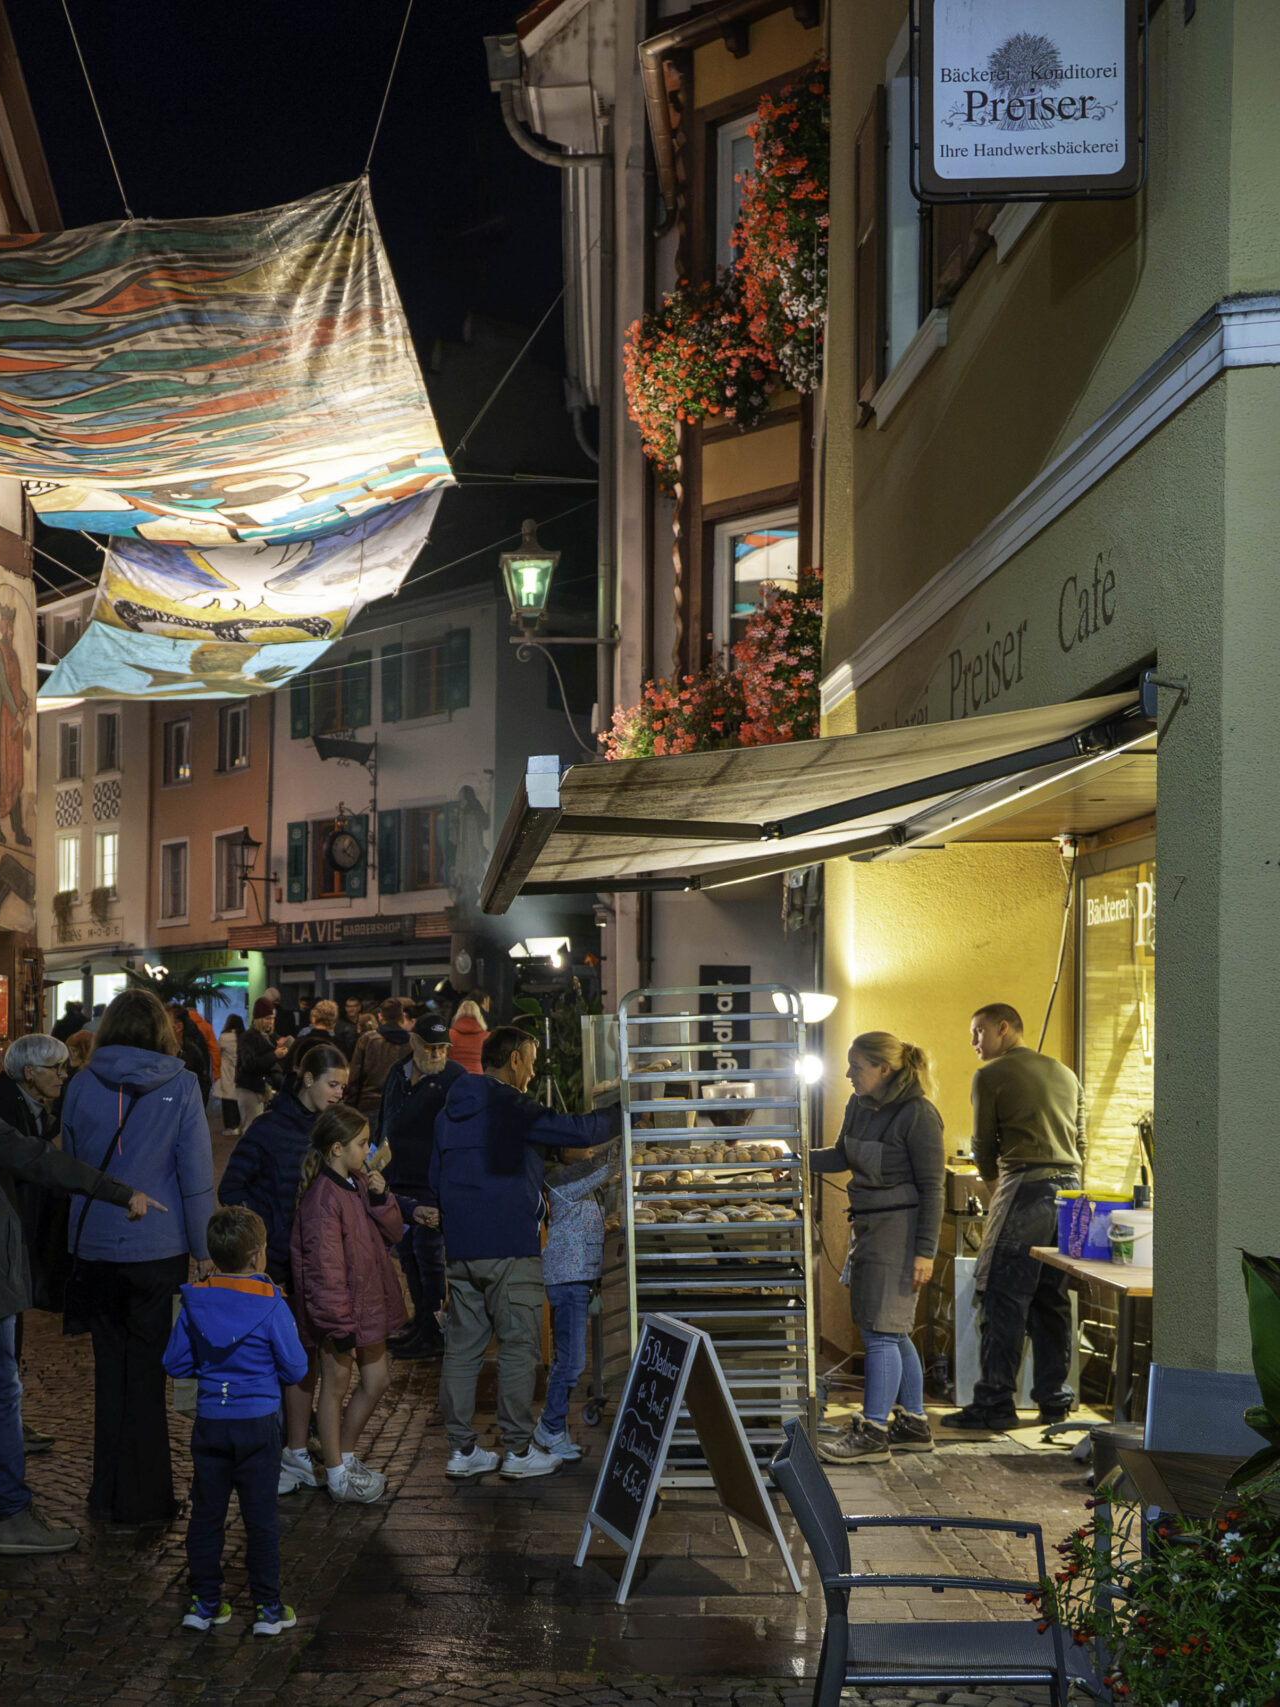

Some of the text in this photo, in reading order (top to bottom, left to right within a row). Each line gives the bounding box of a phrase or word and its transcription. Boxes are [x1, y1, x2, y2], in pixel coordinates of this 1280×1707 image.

[940, 62, 1118, 83] Bäckerei Konditorei
[963, 87, 1094, 123] Preiser
[939, 139, 1120, 158] Ihre Handwerksbäckerei
[948, 619, 1028, 720] Preiser
[1058, 548, 1117, 653] Café
[1087, 889, 1129, 927] Bäckerei
[291, 920, 401, 944] LA VIE BARBERSHOP
[640, 1335, 680, 1380] 5 Berliner
